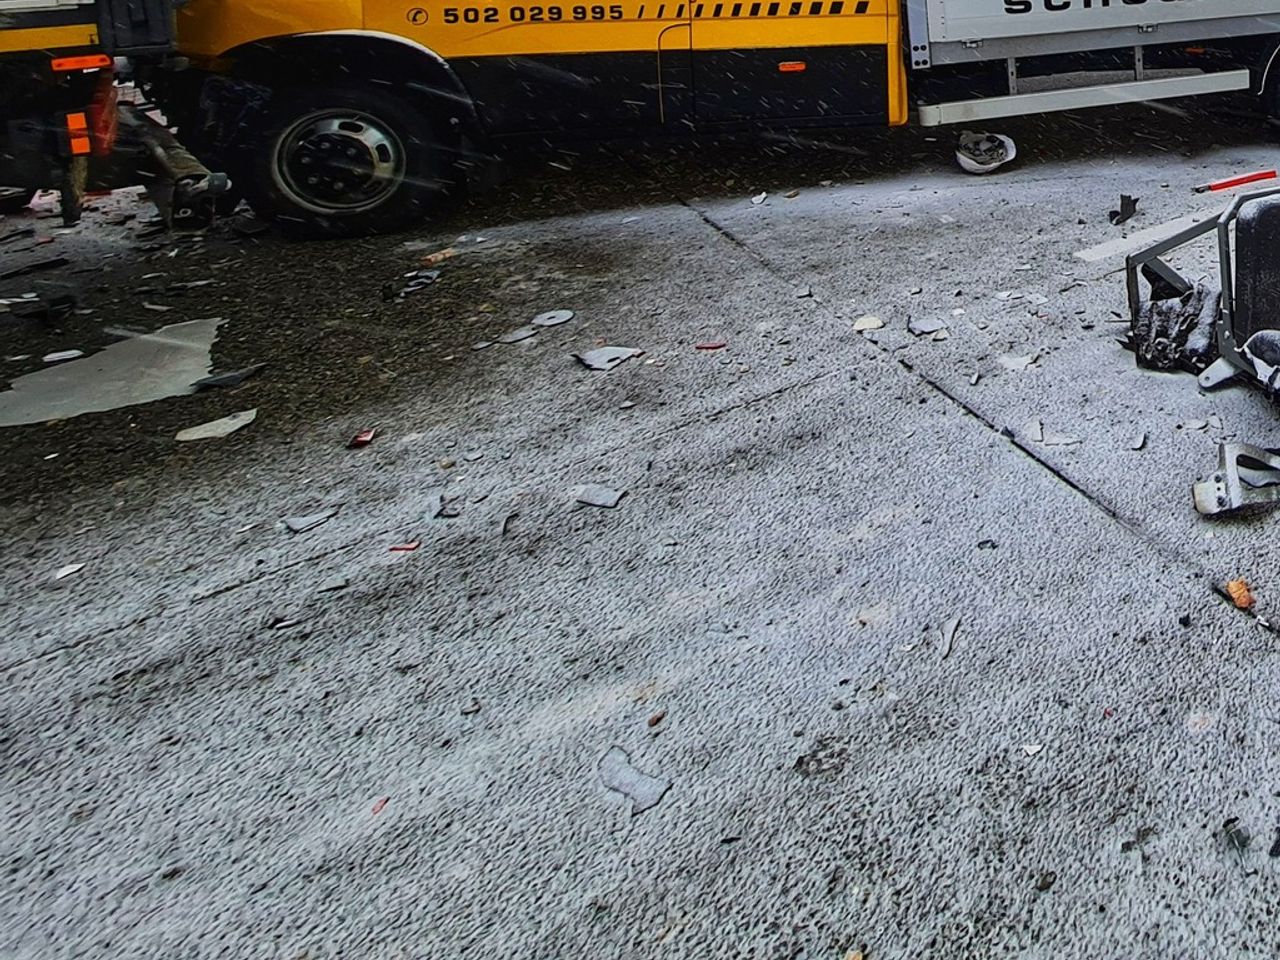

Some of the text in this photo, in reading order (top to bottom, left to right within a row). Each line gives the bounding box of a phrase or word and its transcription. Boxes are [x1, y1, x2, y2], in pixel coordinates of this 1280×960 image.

[443, 5, 624, 24] 502 029 995
